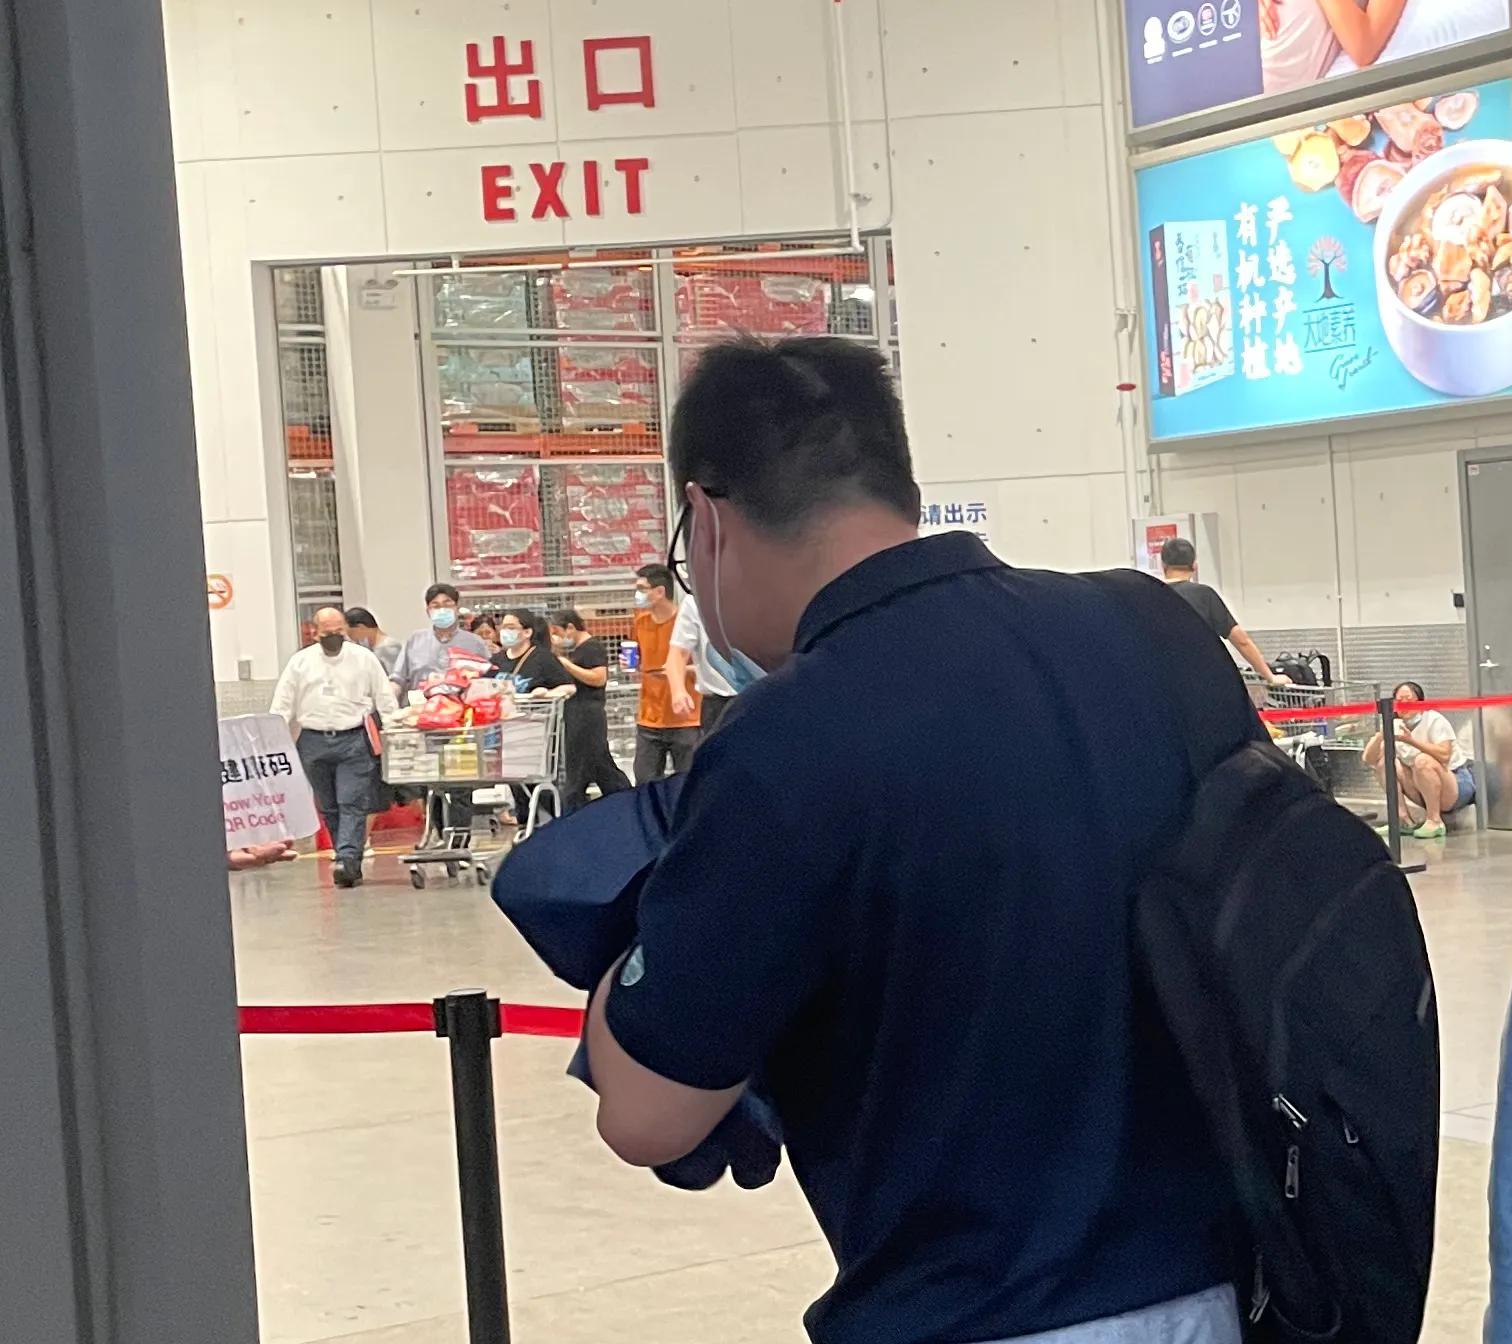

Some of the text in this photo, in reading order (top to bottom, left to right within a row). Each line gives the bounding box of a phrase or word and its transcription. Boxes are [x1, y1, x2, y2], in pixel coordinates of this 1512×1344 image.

[464, 35, 656, 123] 出口
[480, 157, 650, 222] EXIT
[1234, 201, 1271, 380] 有机种植
[1265, 195, 1304, 377] 严选产地
[920, 502, 987, 525] 请出示
